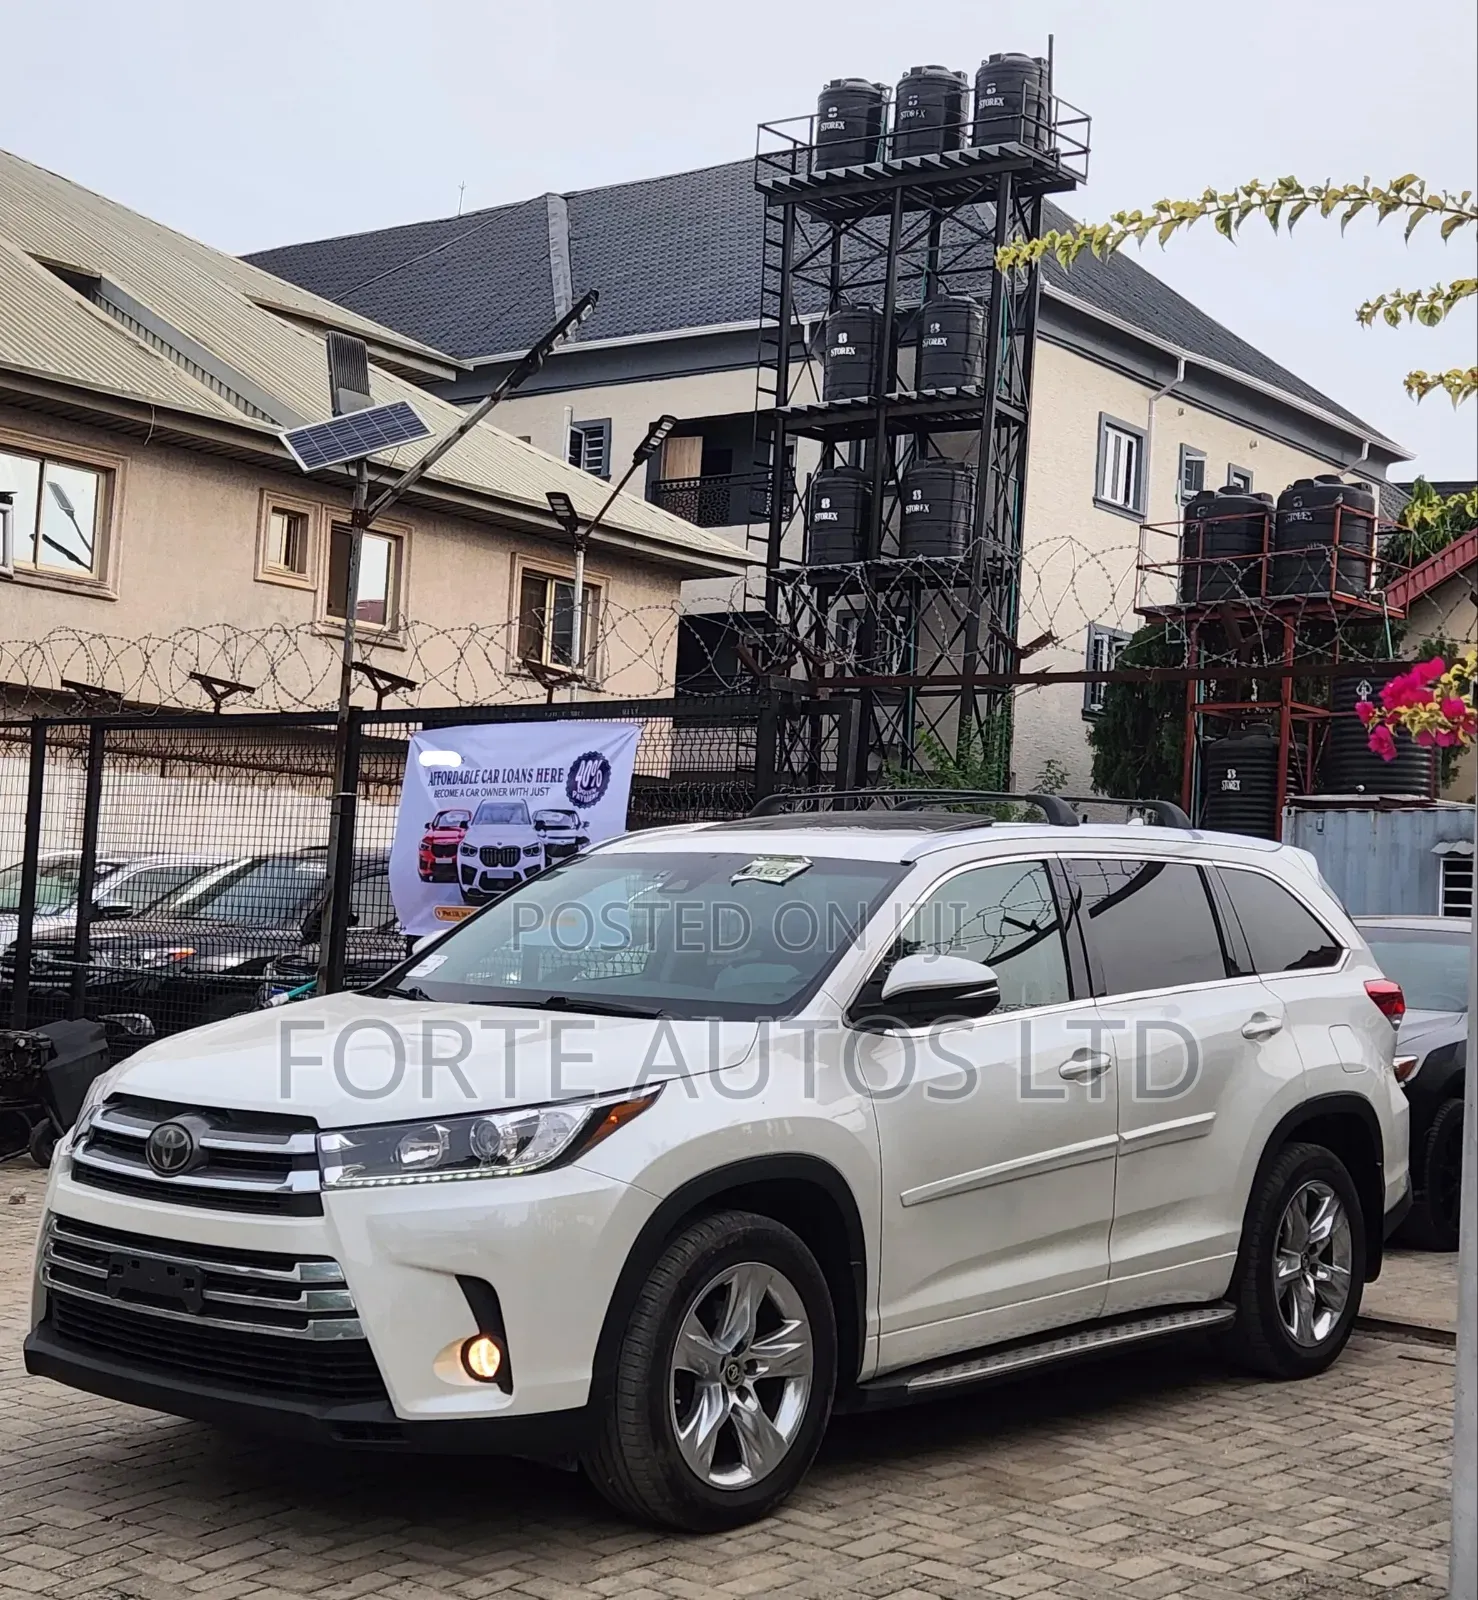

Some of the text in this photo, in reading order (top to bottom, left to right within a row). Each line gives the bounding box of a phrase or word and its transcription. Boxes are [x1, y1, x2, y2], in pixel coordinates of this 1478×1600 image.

[978, 97, 1005, 109] STOREX
[820, 121, 845, 131] STOREX
[922, 337, 948, 348] STOREX
[830, 346, 856, 357] STOREX
[813, 512, 838, 522] STOREX
[428, 767, 565, 787] AFFORDABLE CAR LOANS HERE
[575, 759, 603, 793] 40%
[433, 786, 551, 798] BECOME A CAR OWNER WITH JUST
